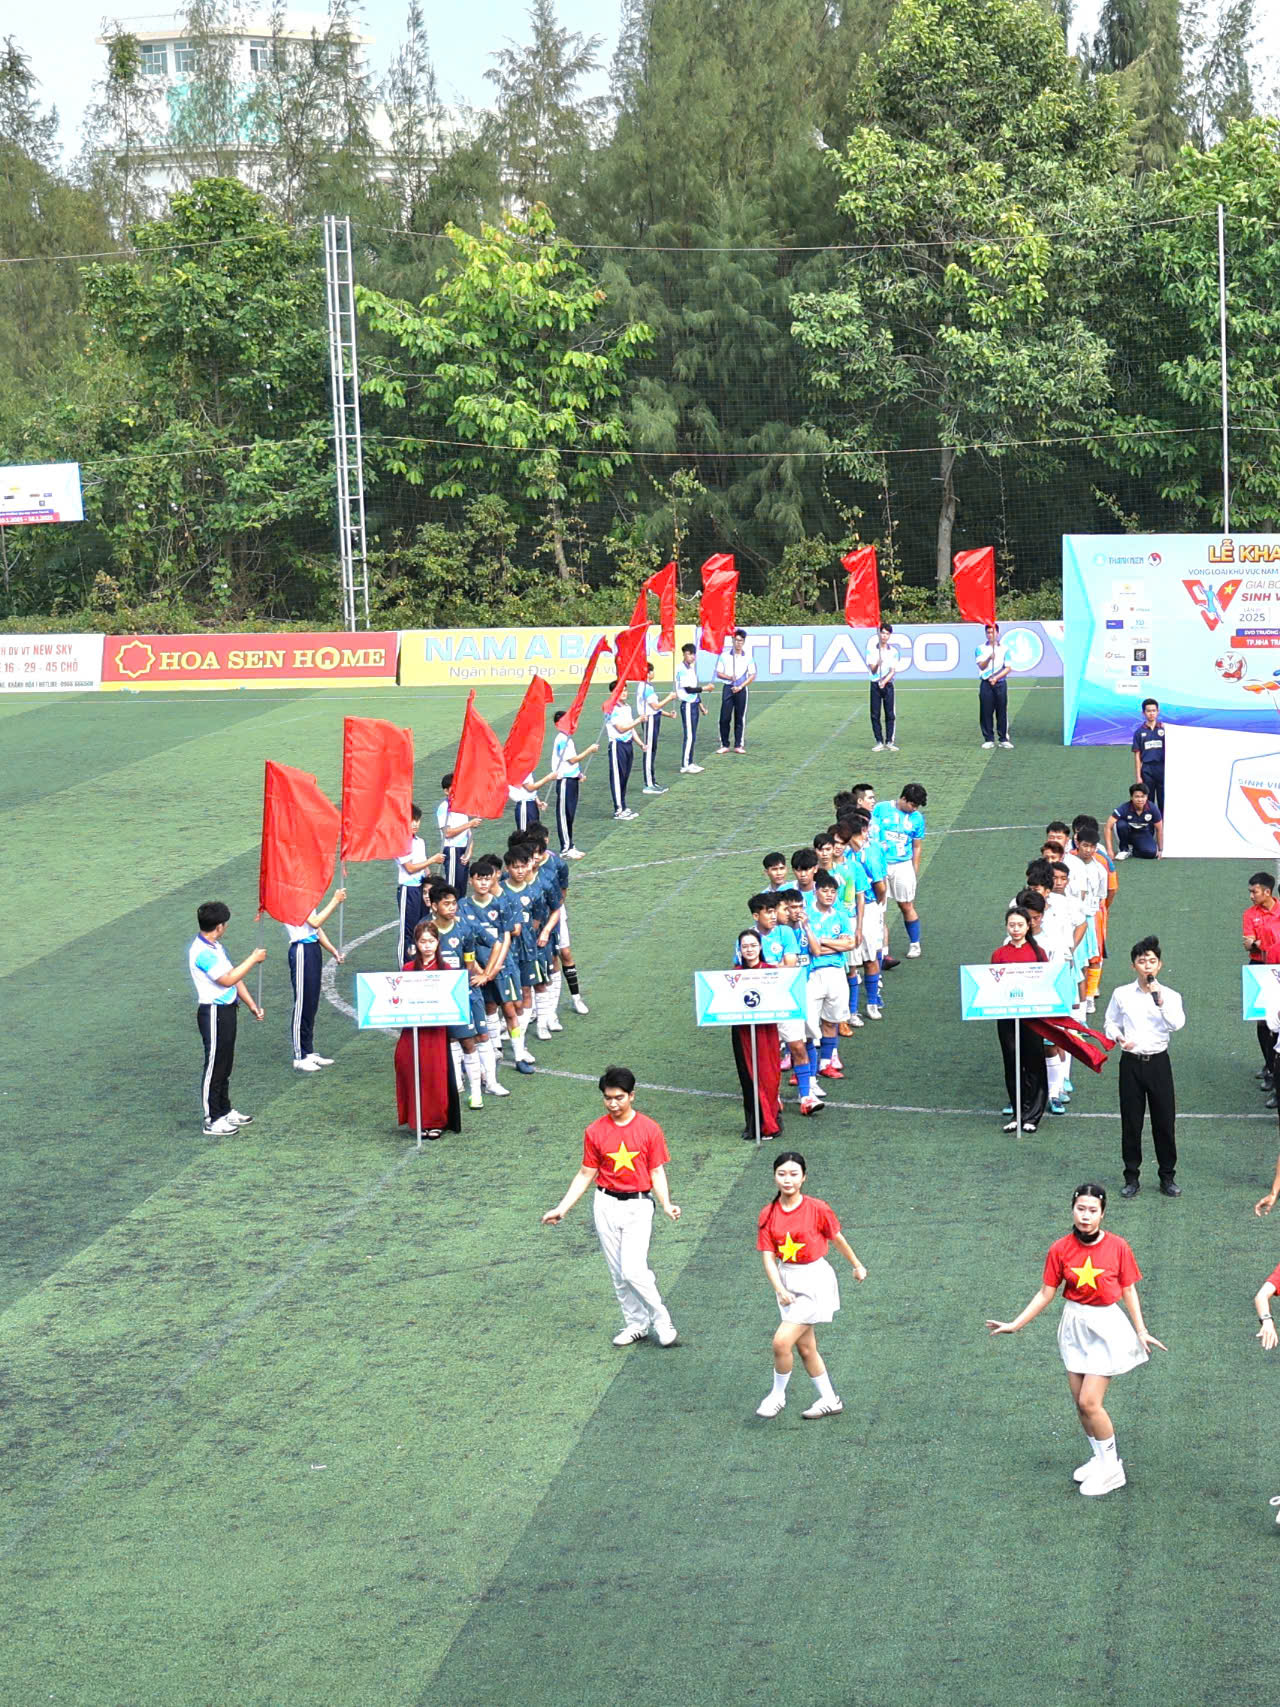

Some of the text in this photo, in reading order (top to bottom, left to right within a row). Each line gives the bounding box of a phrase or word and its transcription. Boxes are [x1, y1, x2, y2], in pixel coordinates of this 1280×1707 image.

[1208, 539, 1235, 563] LỄ
[1241, 592, 1271, 601] SINH
[1240, 613, 1266, 622] 2025
[33, 644, 53, 655] NEW
[56, 644, 72, 655] SKY
[425, 633, 673, 662] NAM A BAK
[159, 646, 386, 670] HOA SEN HOME
[4, 662, 14, 673] 16
[24, 662, 36, 673] 29
[45, 661, 57, 673] 45
